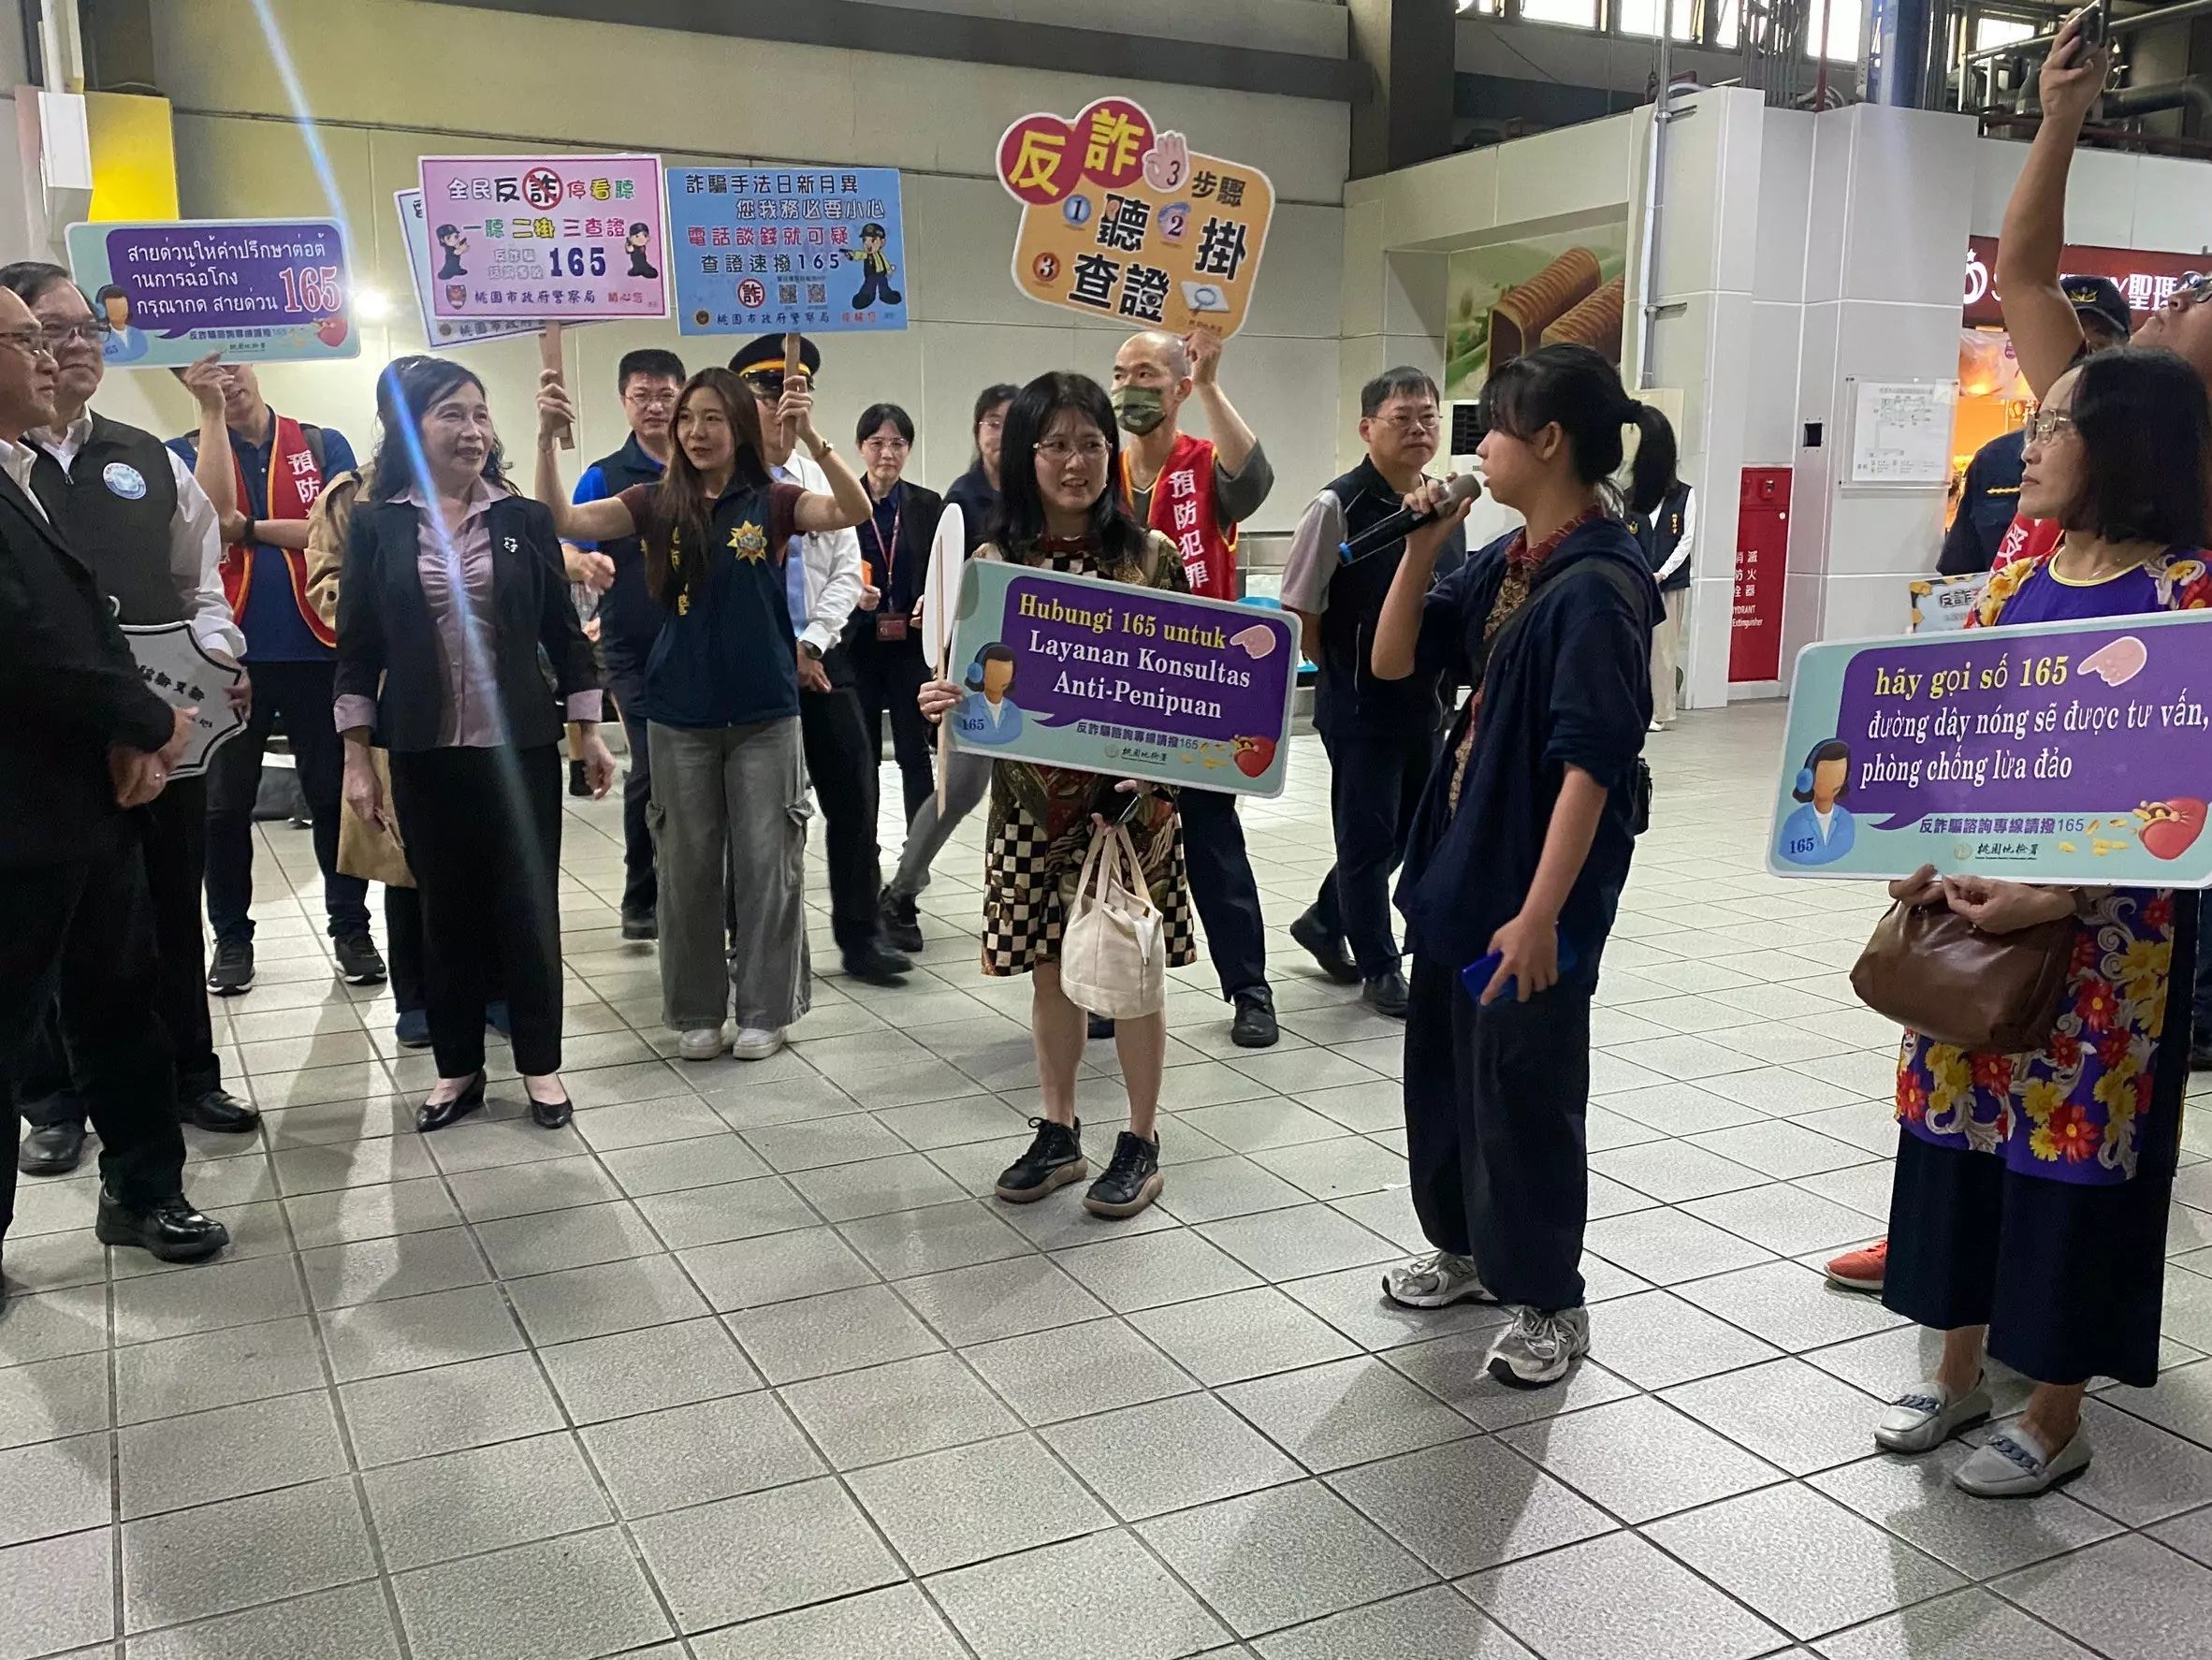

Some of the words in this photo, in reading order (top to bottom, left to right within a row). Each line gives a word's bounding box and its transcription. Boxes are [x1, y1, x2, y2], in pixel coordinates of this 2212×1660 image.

[1008, 108, 1144, 197] 反詐
[686, 174, 858, 195] 詐騙手法日新月異
[1167, 160, 1180, 186] 3
[1191, 171, 1246, 208] 步驟
[736, 198, 885, 220] 您我務必要小心
[1070, 198, 1083, 221] 1
[1168, 215, 1184, 237] 2
[688, 226, 850, 247] 電話談錢就可疑
[549, 246, 607, 278] 165
[137, 299, 208, 318] กรุณากด
[213, 286, 279, 312] สายด่วน
[279, 266, 342, 313] 165
[475, 290, 596, 305] 桃園市政府警察局
[741, 284, 762, 304] 詐
[1038, 257, 1054, 278] 3
[1068, 252, 1171, 323] 查證
[716, 311, 830, 326] 桃園市政府警察局
[286, 449, 320, 519] 預防
[1169, 469, 1210, 590] 預防犯罪
[1733, 604, 1756, 616] YDRANT
[1939, 589, 1983, 608] 反詐
[1018, 592, 1114, 634] Hubungi
[1121, 612, 1157, 637] 165
[1163, 624, 1227, 649] untuk
[1028, 629, 1130, 668] Layanan
[1137, 648, 1251, 688] Konsultas
[1874, 667, 1924, 701] hãy
[1929, 662, 1972, 699] gọi
[1980, 652, 2008, 690] số
[2019, 656, 2070, 687] 165
[1053, 670, 1222, 720] Anti-Penipuan
[962, 717, 985, 732] 165
[1868, 709, 1929, 744] đường
[1934, 706, 1971, 742] dây
[1975, 704, 2030, 740] nóng
[2033, 702, 2058, 733] sẽ
[2063, 700, 2119, 735] được
[2127, 699, 2153, 729] tư
[2161, 688, 2209, 732] vấn,
[1859, 753, 1923, 789] phòng
[1927, 745, 1988, 787] chống
[1992, 750, 2026, 779] lừa
[2033, 747, 2073, 779] đảo
[1789, 837, 1814, 853] 165
